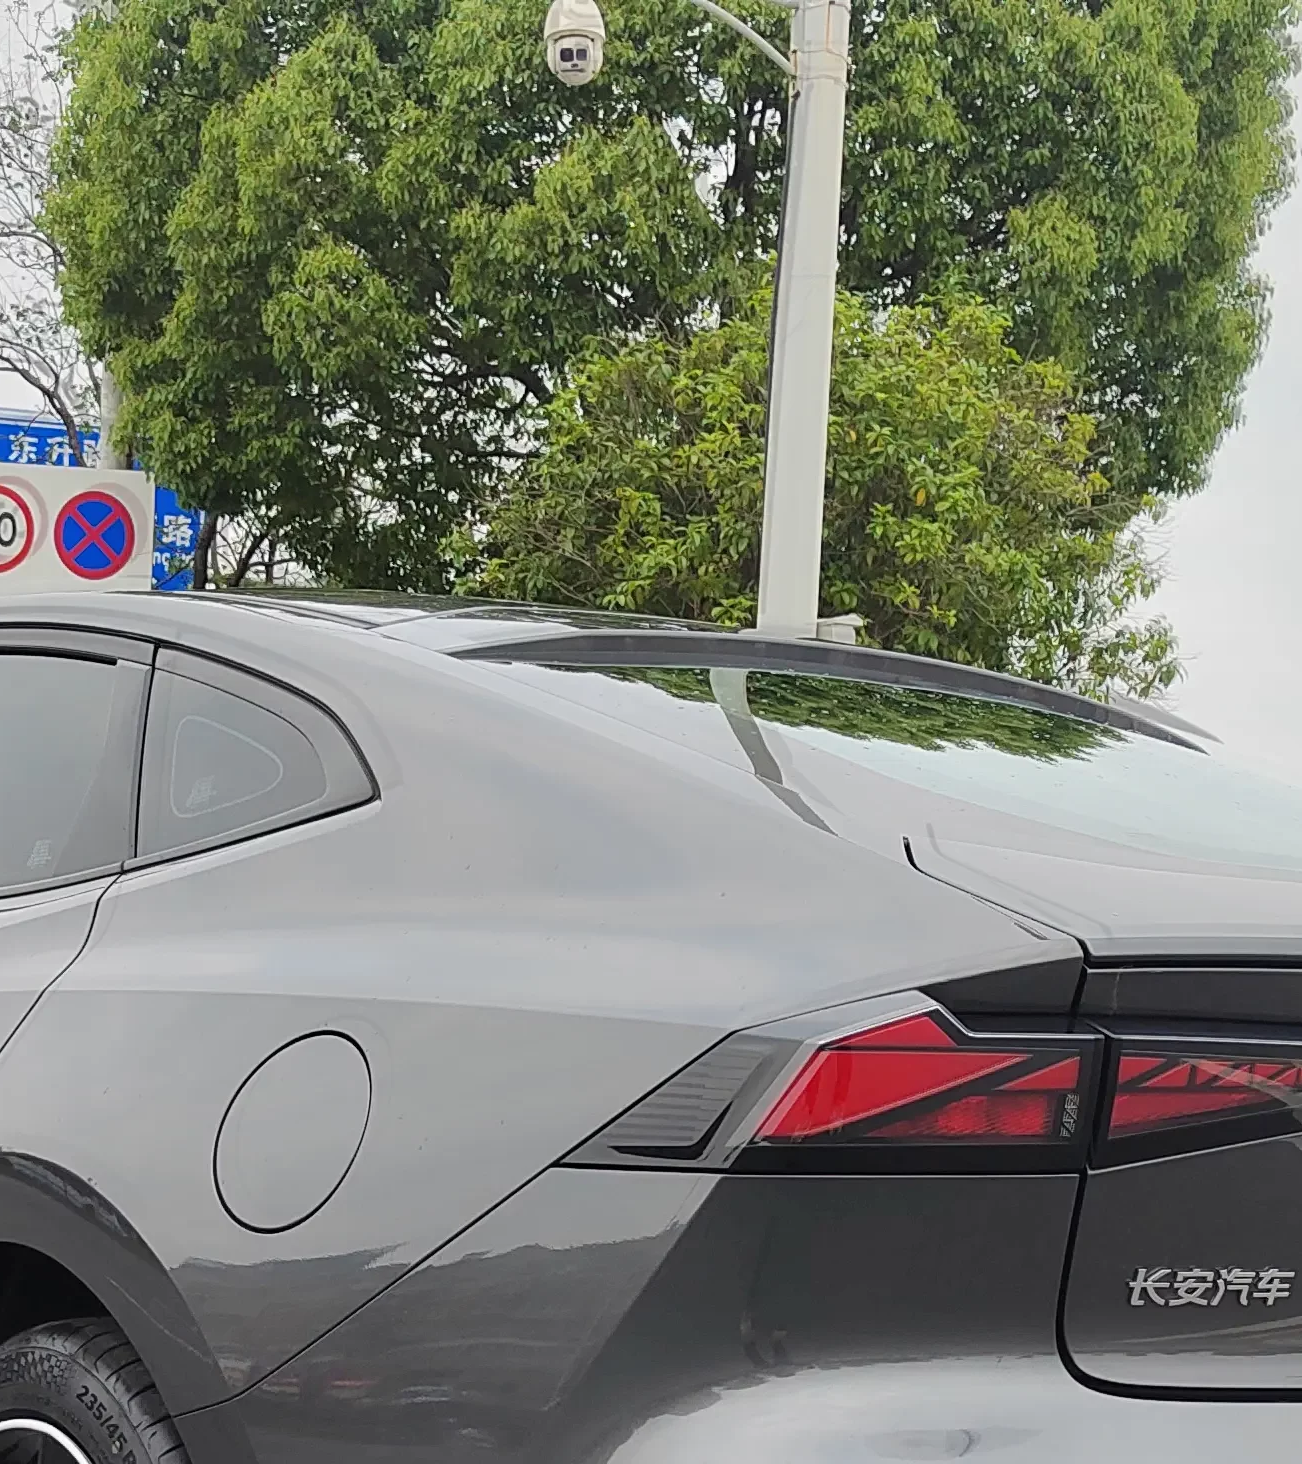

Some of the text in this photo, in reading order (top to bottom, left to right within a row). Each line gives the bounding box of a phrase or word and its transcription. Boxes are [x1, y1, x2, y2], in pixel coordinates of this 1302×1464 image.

[1128, 1268, 1296, 1306] 长安汽车
[76, 1385, 128, 1451] 235/45
